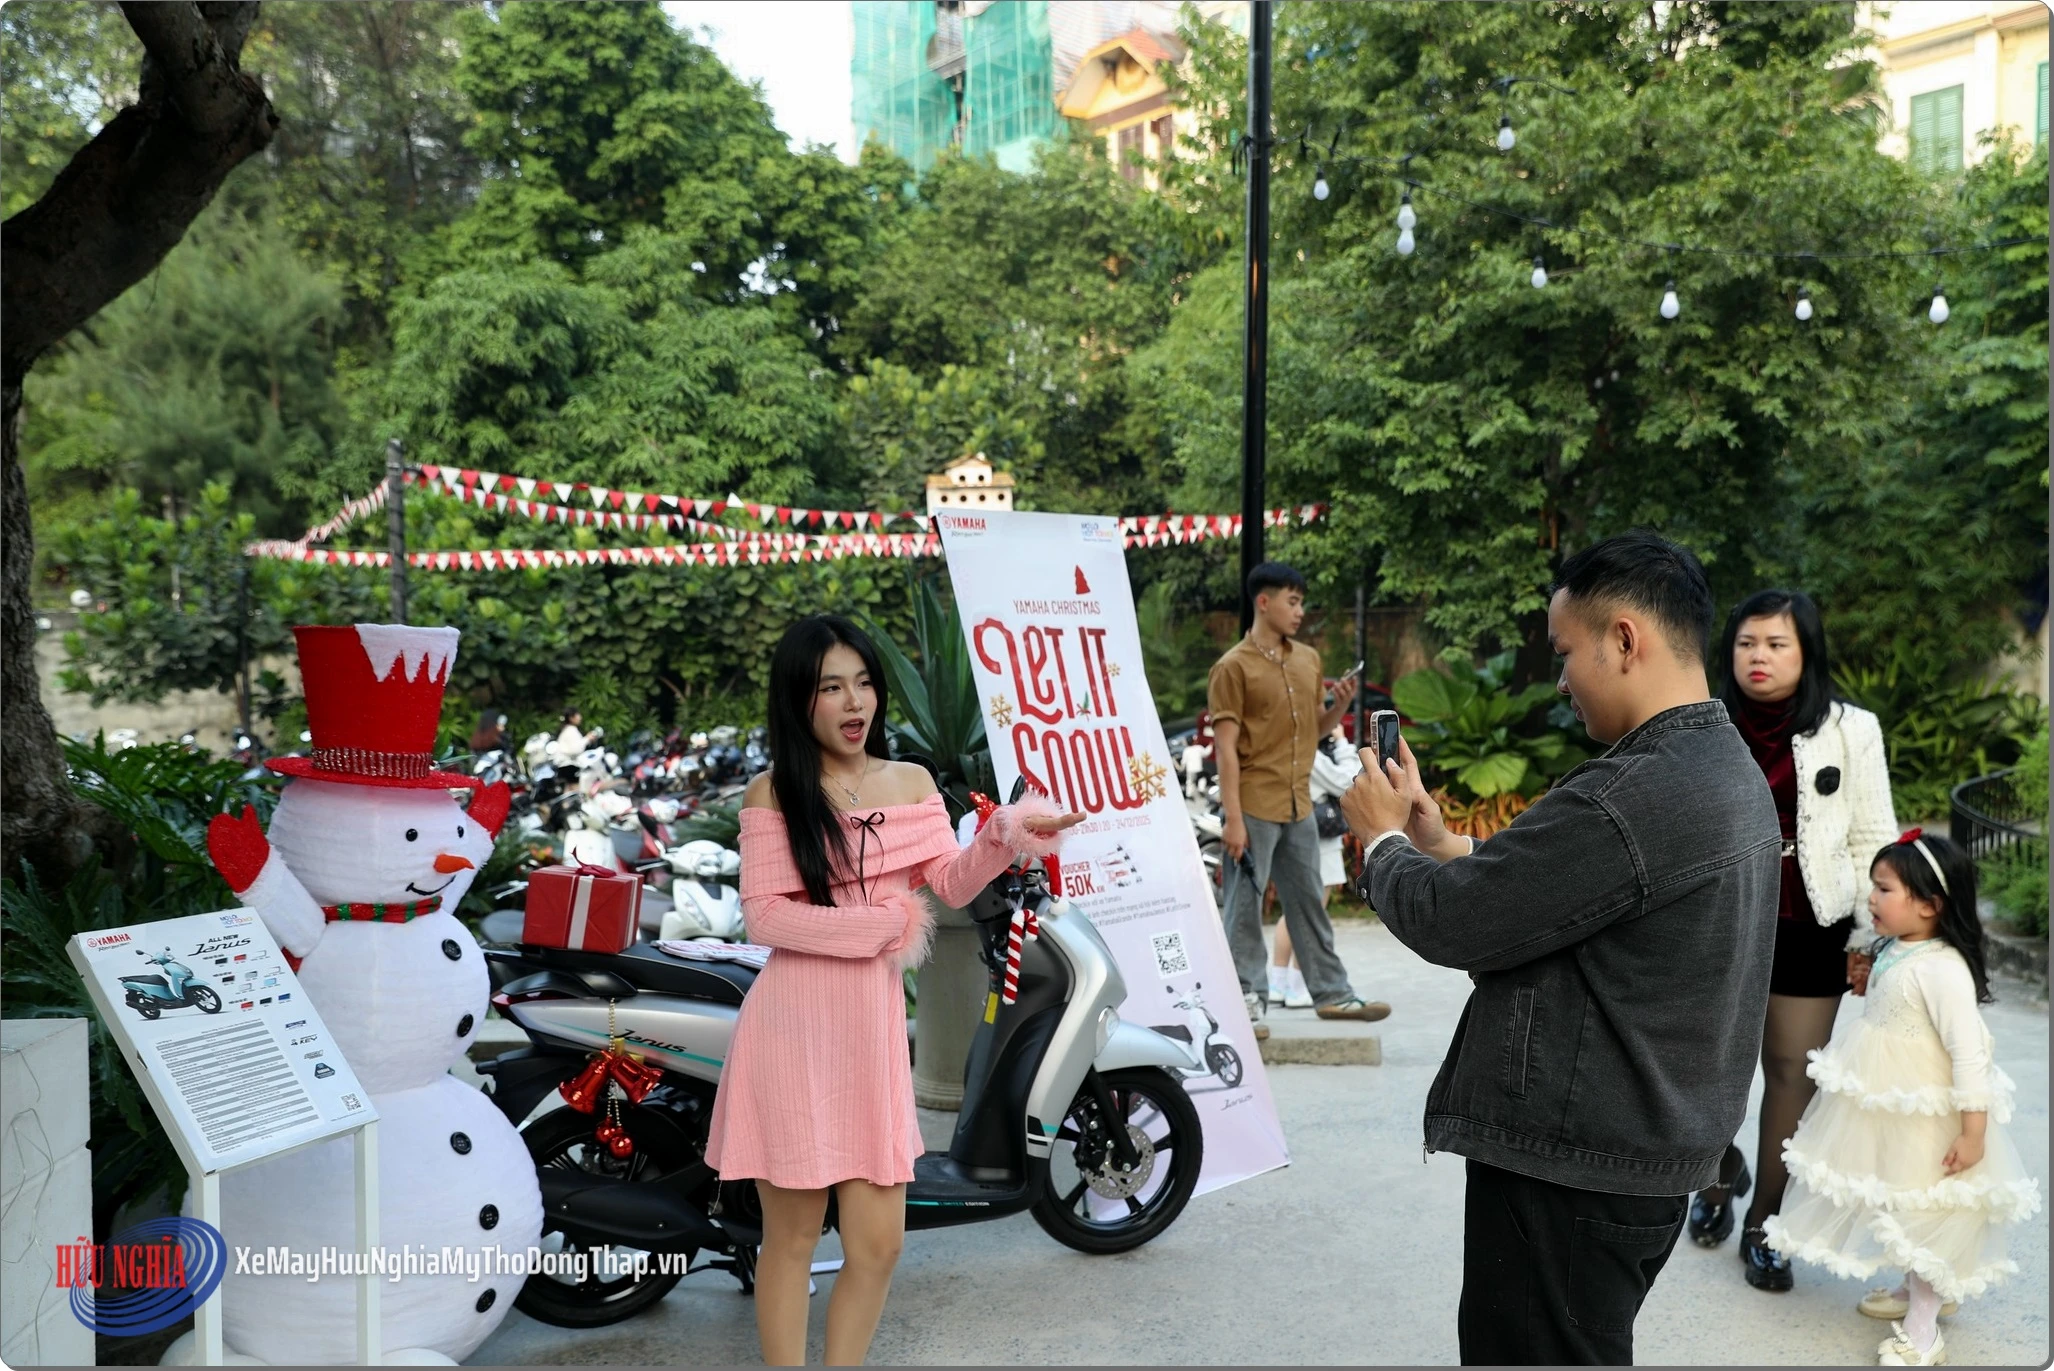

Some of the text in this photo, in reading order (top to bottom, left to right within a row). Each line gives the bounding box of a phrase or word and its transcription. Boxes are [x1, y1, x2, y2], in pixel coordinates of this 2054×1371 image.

[951, 516, 987, 531] YAMAHA
[1013, 600, 1101, 615] YAMAHA CHRISTMAS
[1078, 626, 1118, 718] IT
[1061, 861, 1091, 875] VOUCHER
[1065, 874, 1096, 898] 50K
[96, 933, 132, 946] YAMAHA
[187, 938, 252, 957] Janus
[605, 1028, 687, 1053] Janus
